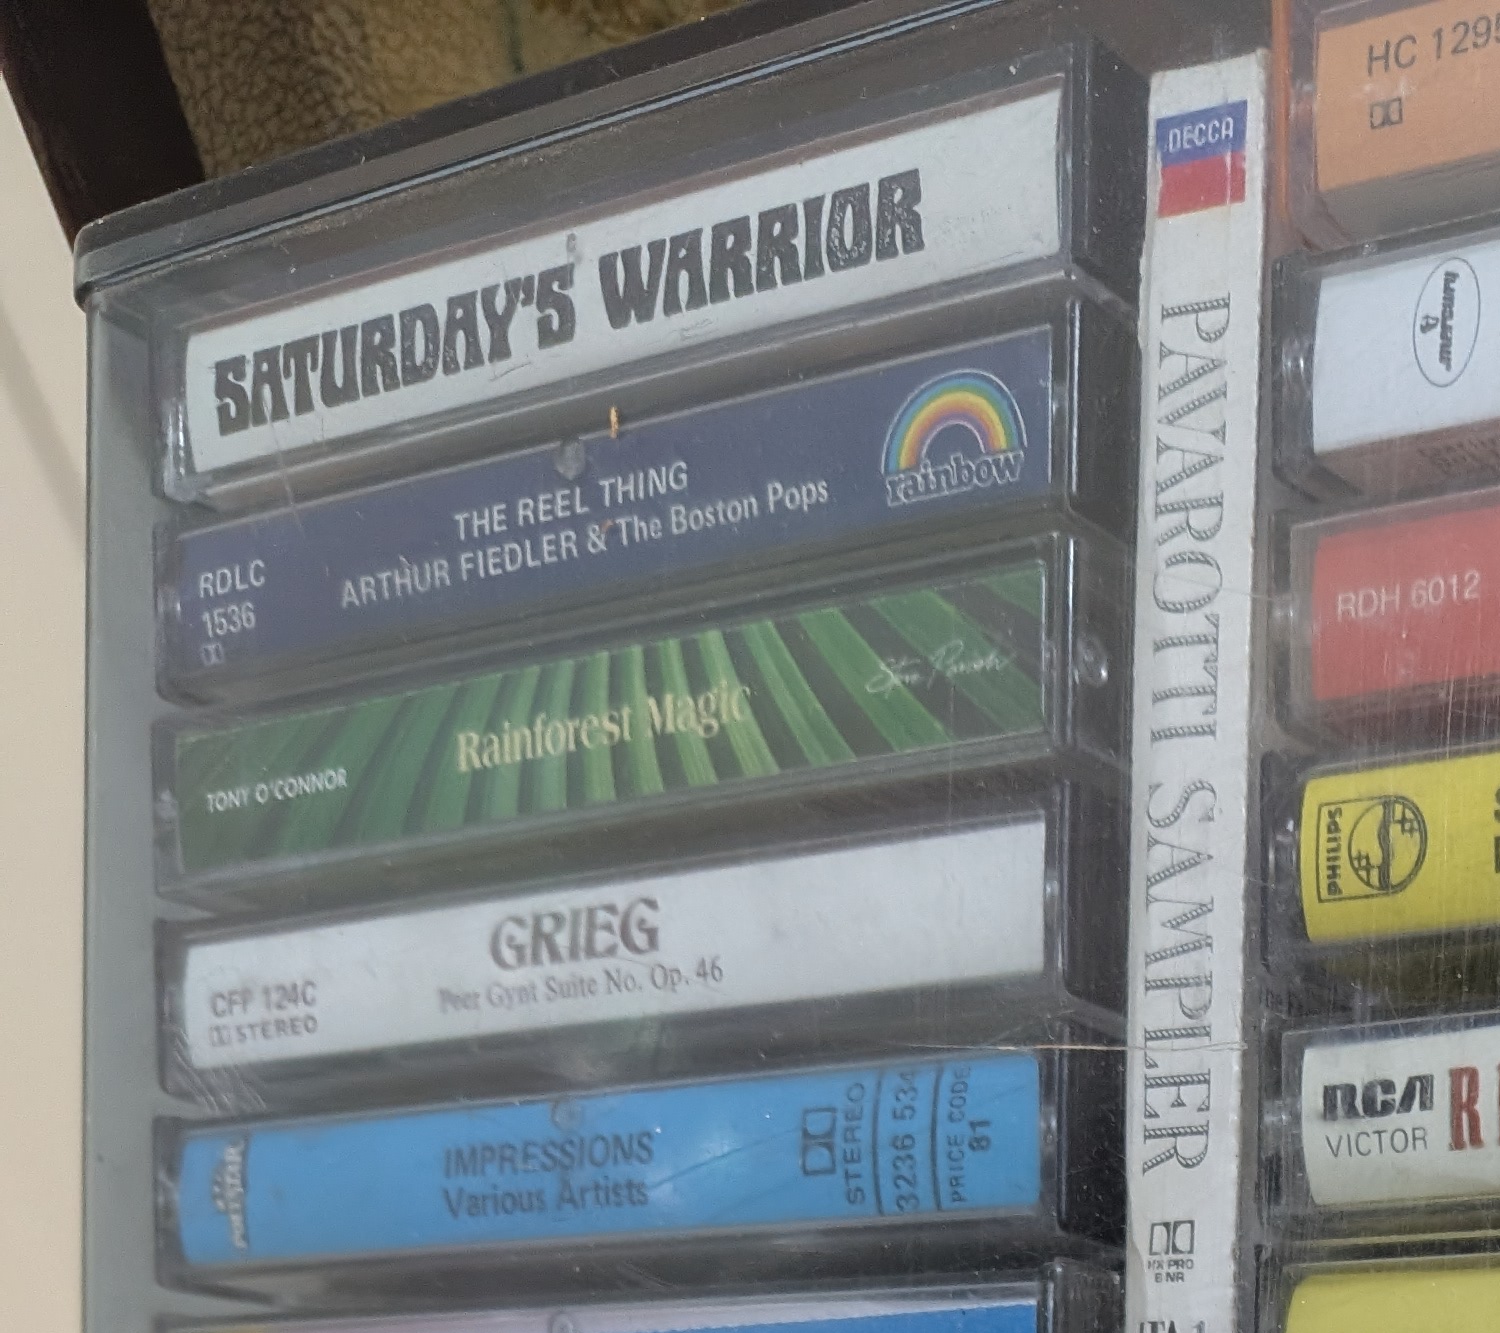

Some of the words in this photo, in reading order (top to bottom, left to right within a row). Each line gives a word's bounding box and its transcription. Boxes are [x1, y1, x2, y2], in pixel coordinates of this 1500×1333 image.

[1165, 117, 1234, 153] DECCA
[599, 167, 924, 329] WARRIOR
[455, 504, 507, 541] THE
[616, 515, 662, 546] The
[767, 478, 829, 513] Pops
[1151, 292, 1231, 741] PAVAROTTI
[201, 560, 266, 597] RDLC
[201, 603, 255, 637] 1536
[1337, 585, 1399, 622] RDH
[207, 788, 248, 812] TONY
[1326, 806, 1343, 897] PHILIPS
[489, 897, 659, 971] GRIEG
[544, 974, 597, 1003] Suite
[604, 966, 643, 996] No.
[651, 963, 689, 992] Op.
[695, 956, 724, 985] 46
[1143, 779, 1217, 1176] SAMPLER
[235, 1015, 318, 1043] STEREO
[948, 1064, 971, 1123] CODE
[1322, 1073, 1433, 1121] RCA
[443, 1131, 653, 1179] IMPRESSIONS
[843, 1081, 867, 1206] STEREO
[1325, 1125, 1429, 1160] VICTOR
[892, 1133, 919, 1213] 3236
[947, 1134, 967, 1204] PRICE
[443, 1184, 546, 1220] Various
[556, 1176, 648, 1211] Artists
